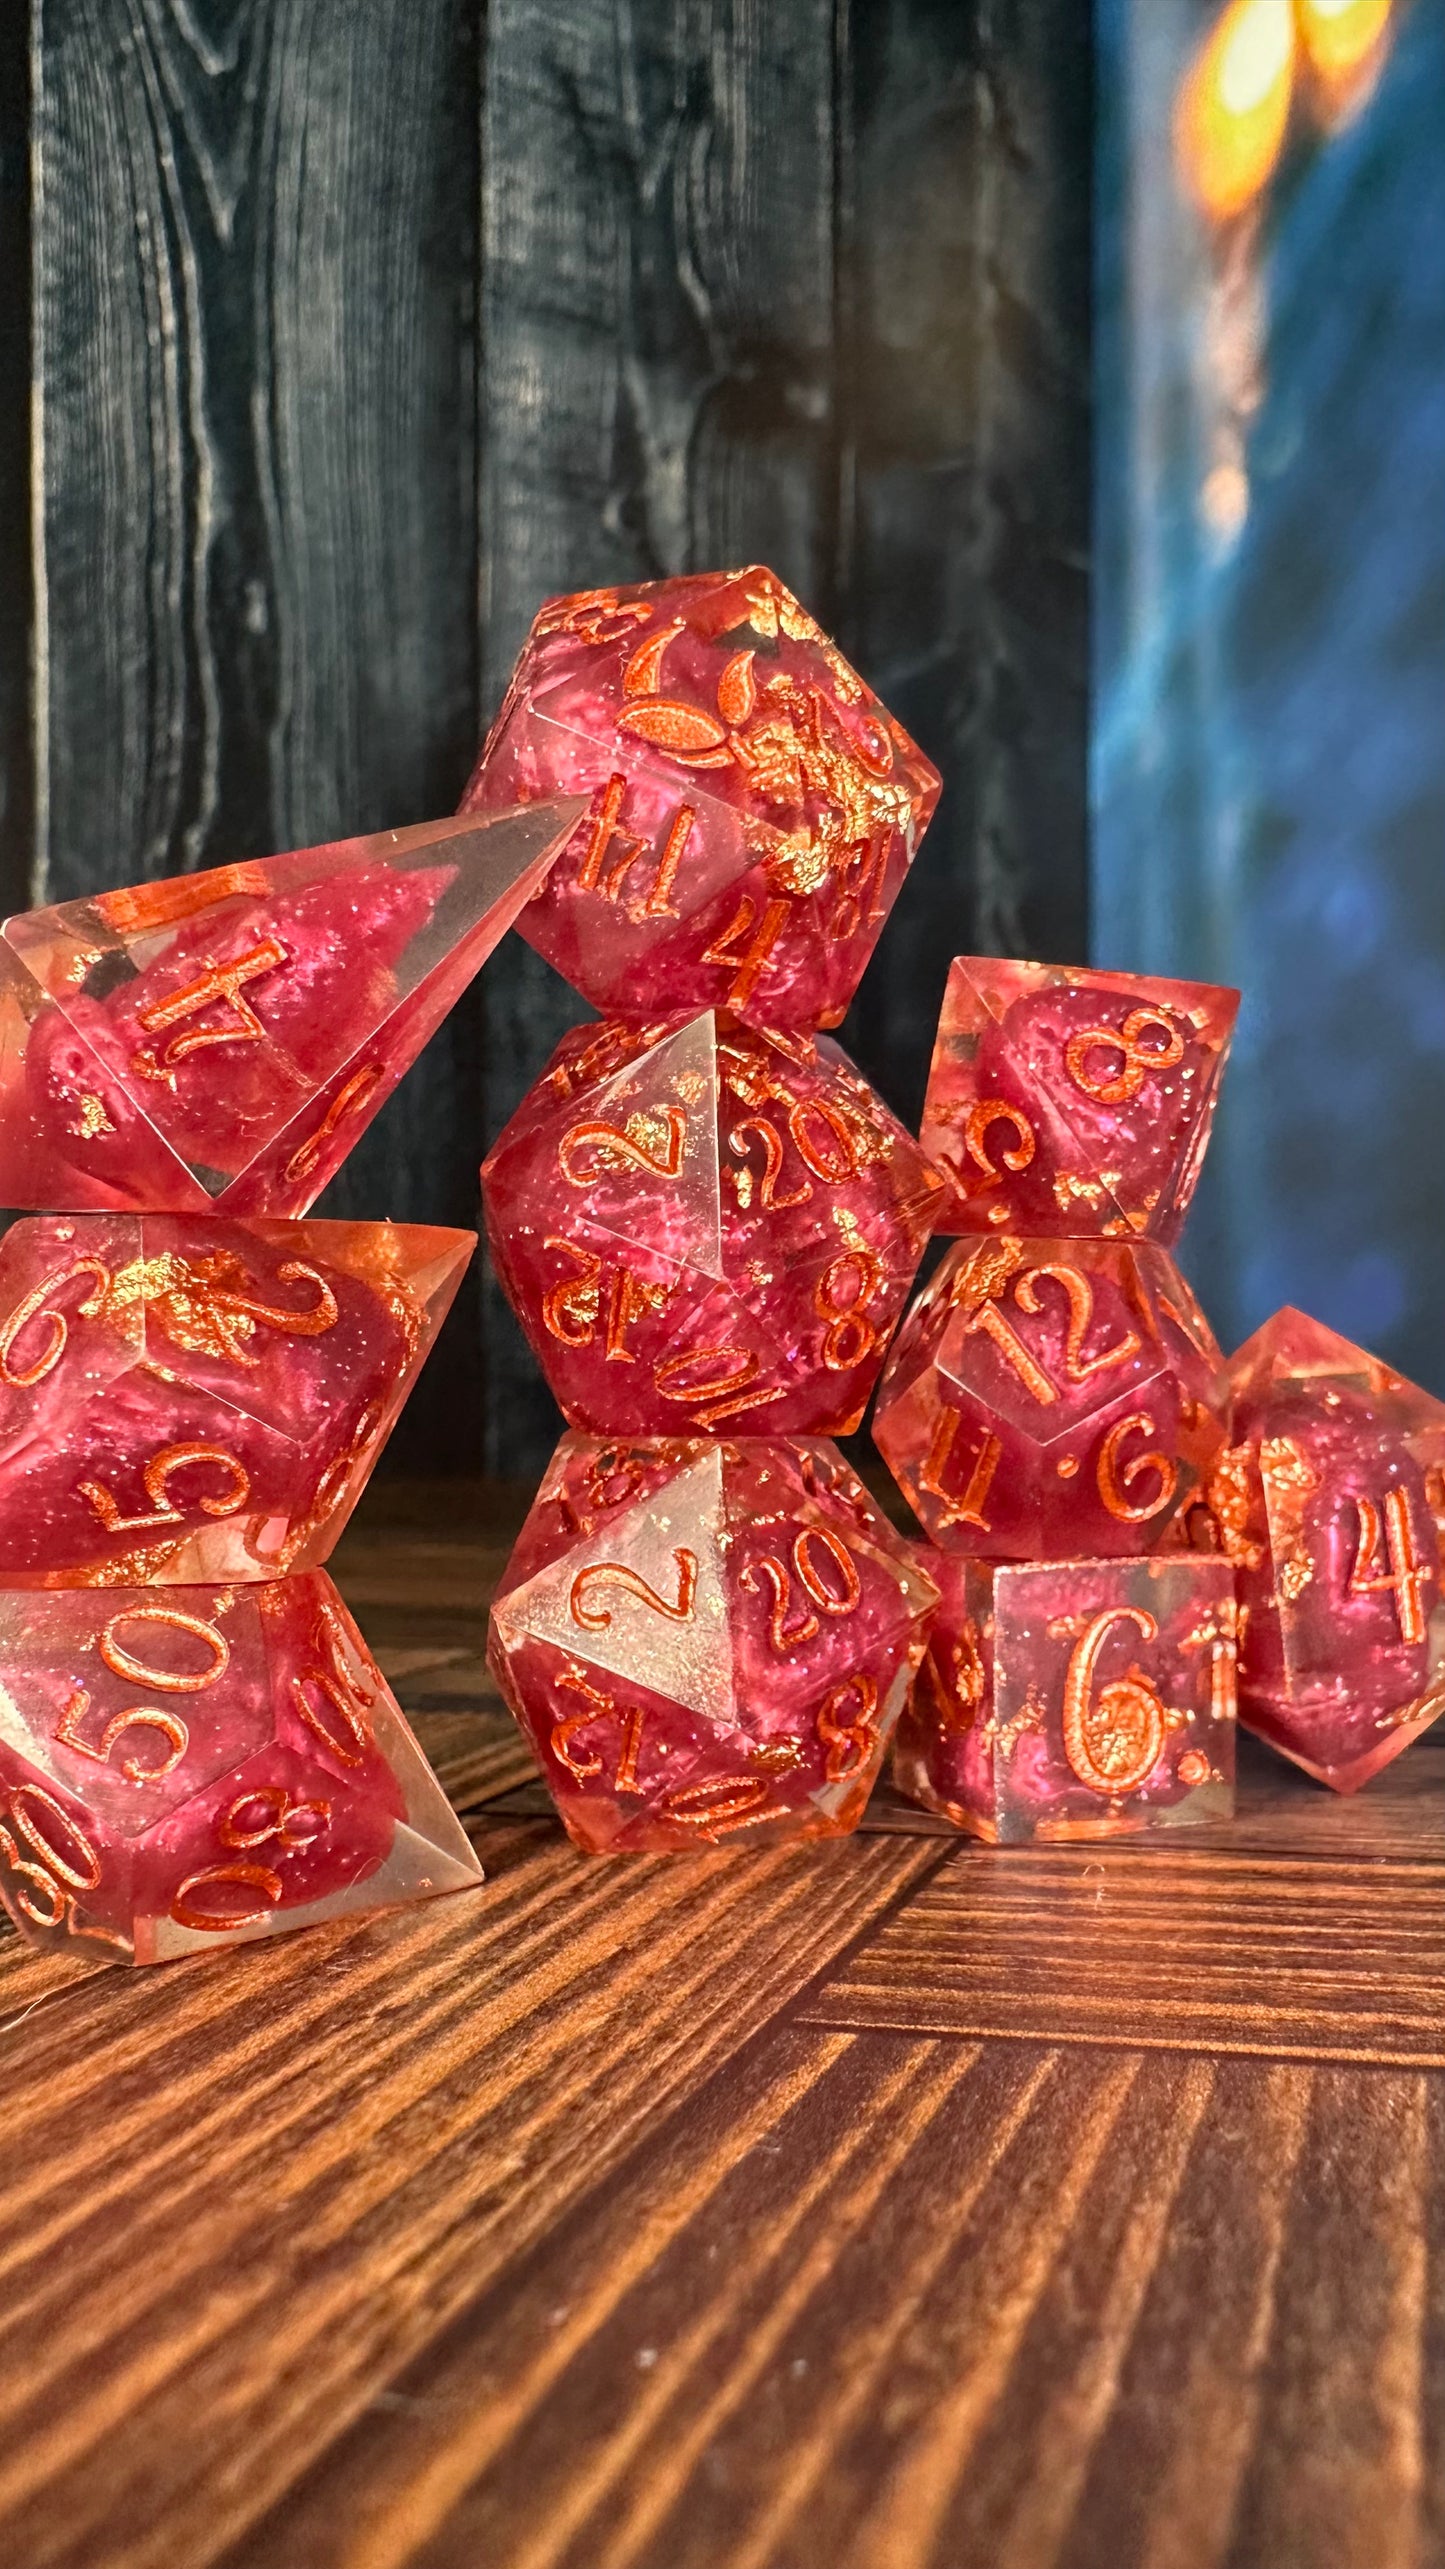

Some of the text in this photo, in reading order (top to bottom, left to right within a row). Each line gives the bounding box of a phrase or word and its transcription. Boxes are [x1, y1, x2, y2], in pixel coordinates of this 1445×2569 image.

[138, 938, 288, 1066] 4
[701, 895, 793, 1010] 4
[1064, 1007, 1185, 1106] 8
[558, 1103, 687, 1189] 2
[728, 1098, 860, 1212] 20
[815, 1249, 887, 1371] 8
[964, 1261, 1142, 1406] 12
[77, 1441, 250, 1533] 5
[570, 1547, 697, 1632] 2
[738, 1524, 861, 1651] 20
[1352, 1484, 1433, 1646] 4
[54, 1604, 230, 1783] 50
[815, 1673, 883, 1784] 8
